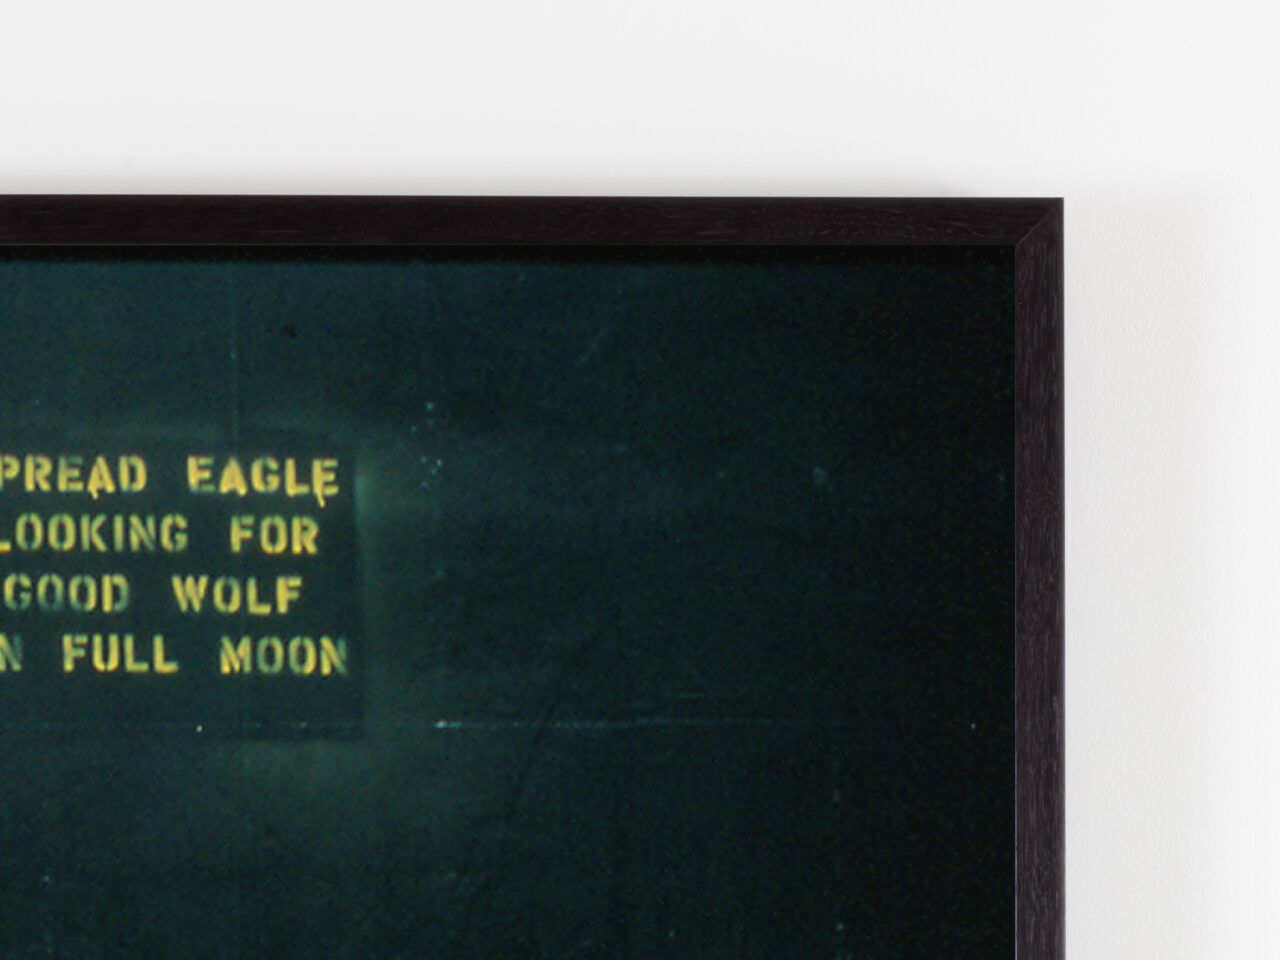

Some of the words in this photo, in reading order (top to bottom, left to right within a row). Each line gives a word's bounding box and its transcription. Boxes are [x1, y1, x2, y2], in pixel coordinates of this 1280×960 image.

[186, 455, 340, 502] EAGLE
[230, 515, 320, 555] FOR
[3, 573, 130, 614] GOOD
[172, 574, 303, 616] WOLF
[62, 633, 179, 674] FULL
[220, 635, 348, 675] MOON
